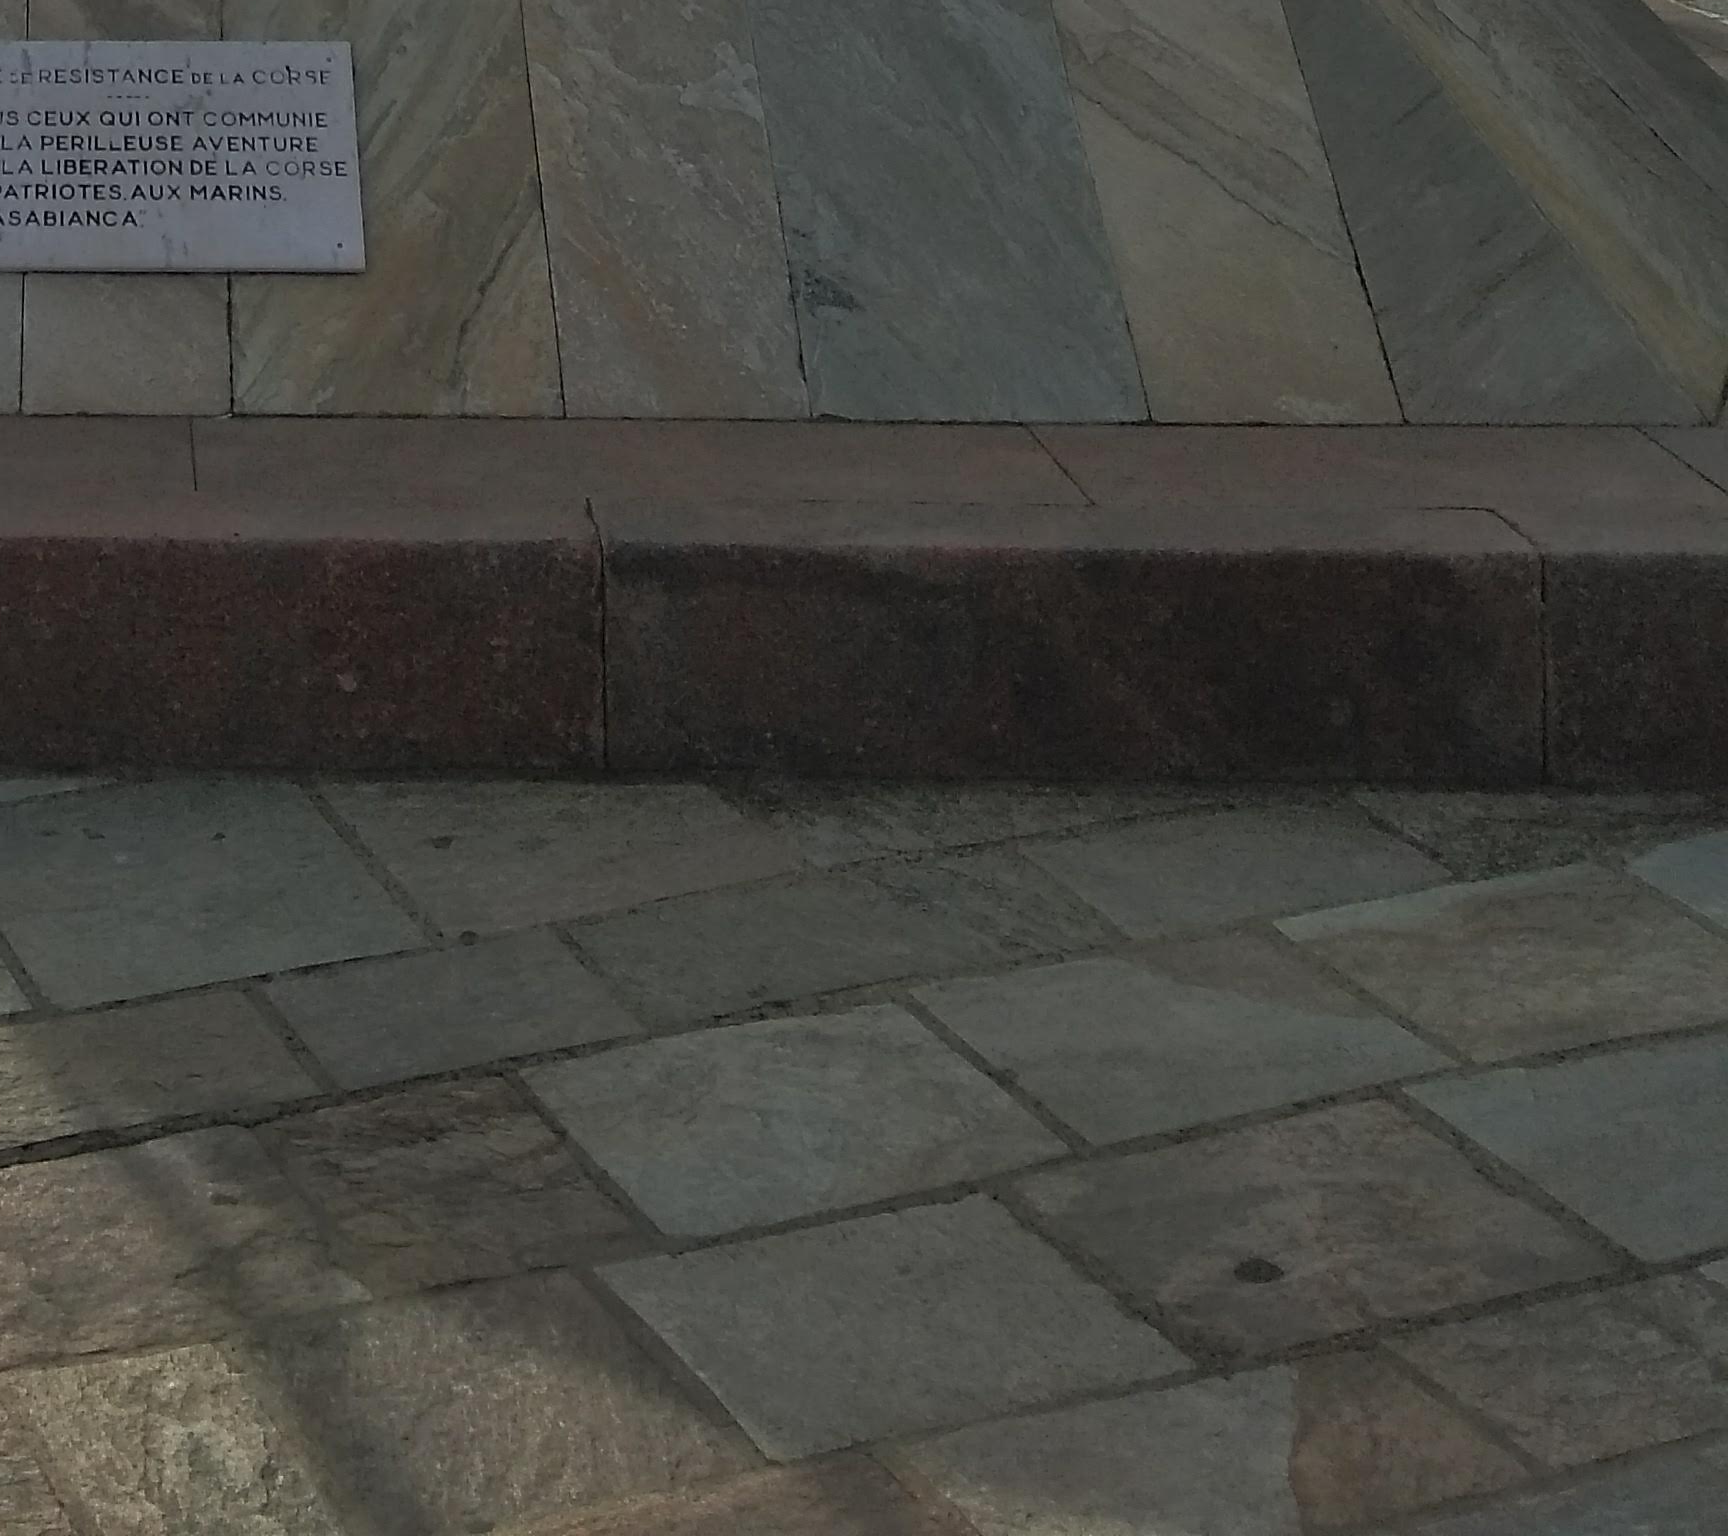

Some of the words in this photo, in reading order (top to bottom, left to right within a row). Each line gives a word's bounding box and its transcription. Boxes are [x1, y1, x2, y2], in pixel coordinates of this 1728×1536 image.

[38, 68, 184, 84] RESISTANCE
[191, 72, 213, 85] DE
[221, 73, 245, 85] LA
[252, 68, 332, 86] CORSE
[27, 111, 91, 127] CEUX
[99, 111, 140, 127] QUI
[147, 111, 195, 127] ONT
[203, 111, 328, 128] COMMUNIE
[0, 134, 33, 151] LA
[40, 135, 183, 151] PERILLEUSE
[192, 136, 319, 153] AVENTURE
[1, 159, 33, 175] LA
[41, 159, 183, 176] LIBERATION
[190, 160, 217, 176] DE
[226, 160, 257, 176] LA
[266, 160, 348, 177] CORSE
[131, 184, 181, 201] AUX
